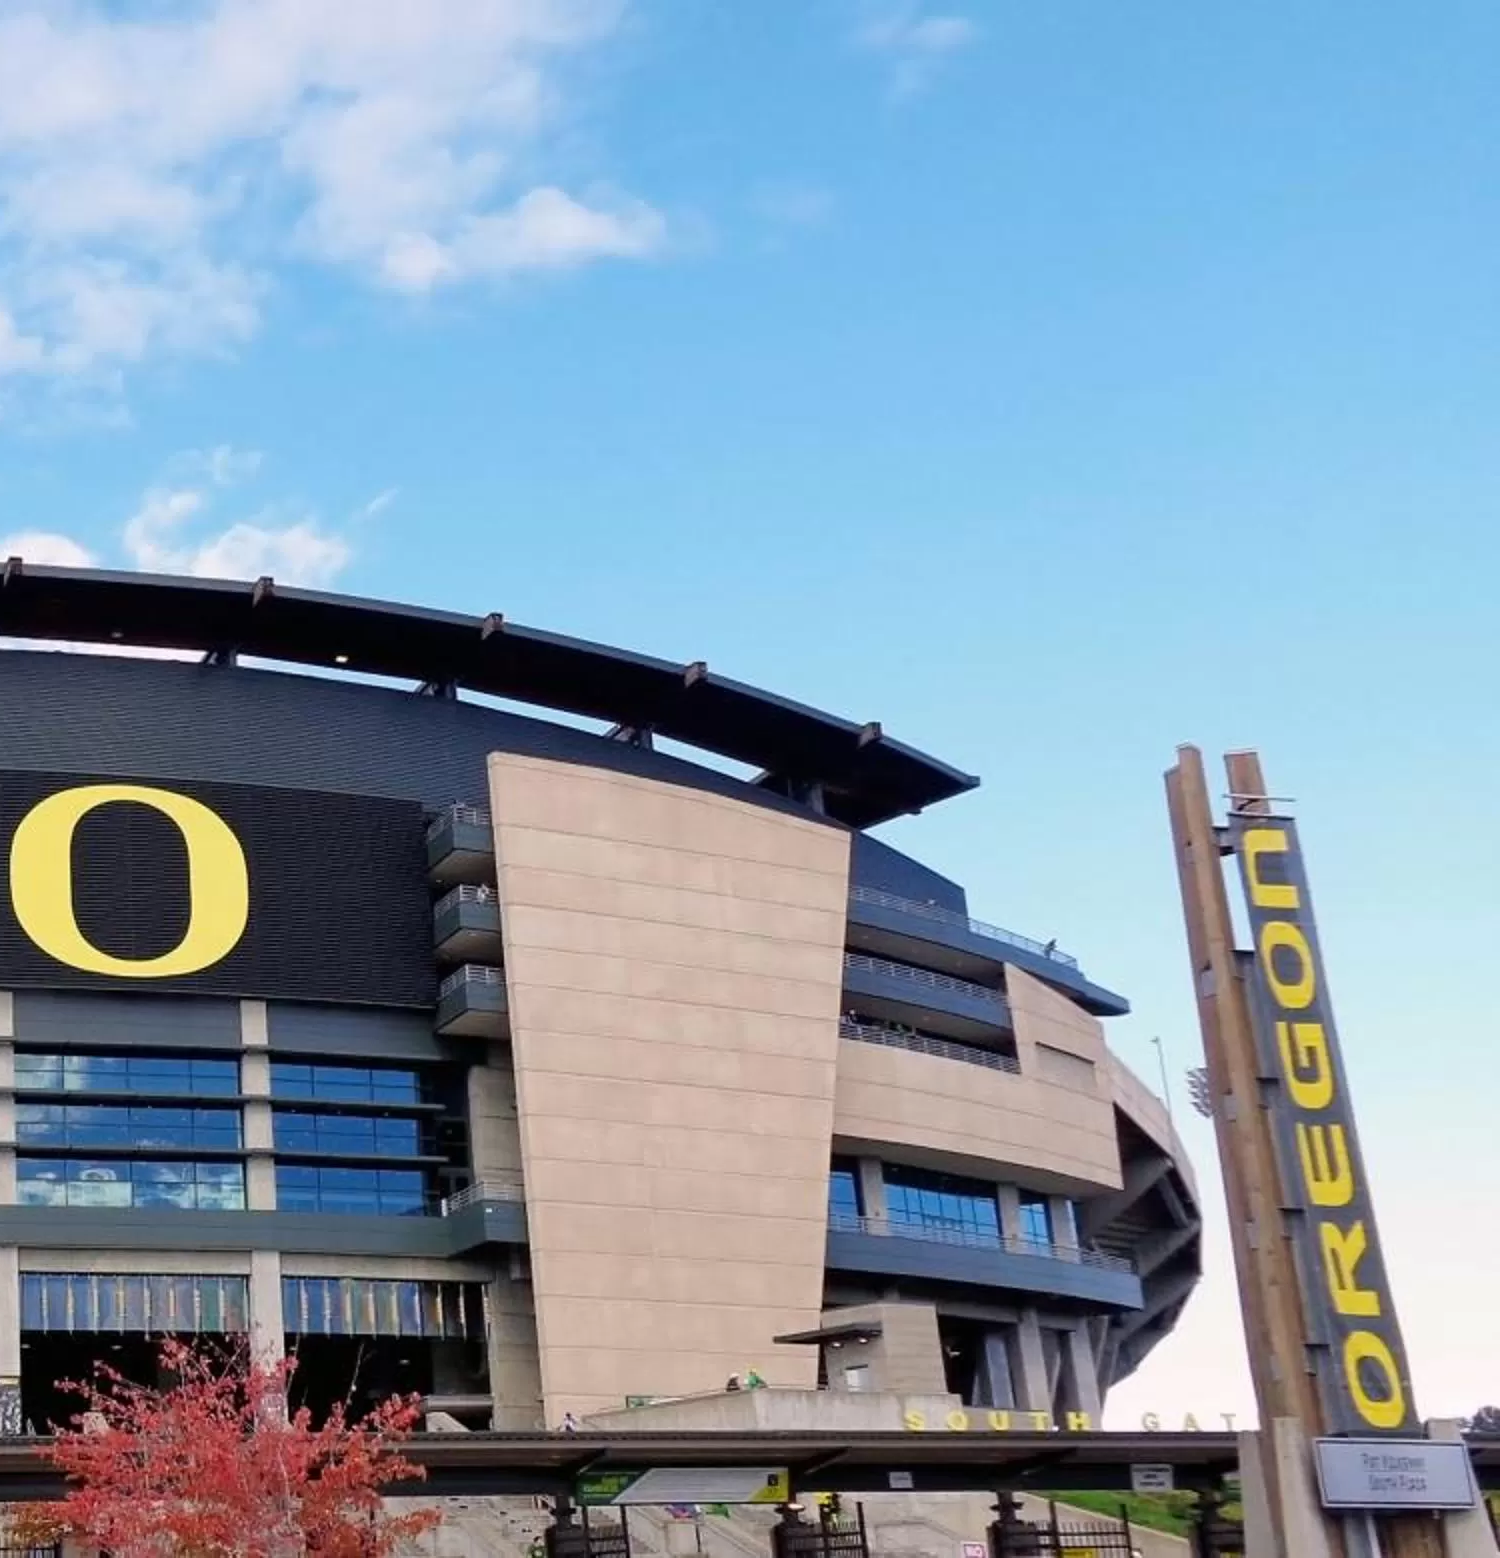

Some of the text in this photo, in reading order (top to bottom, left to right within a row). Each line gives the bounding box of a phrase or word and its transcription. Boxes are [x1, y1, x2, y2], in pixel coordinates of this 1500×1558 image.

[9, 785, 249, 977] O
[904, 1410, 1237, 1432] SOUTH GAT
